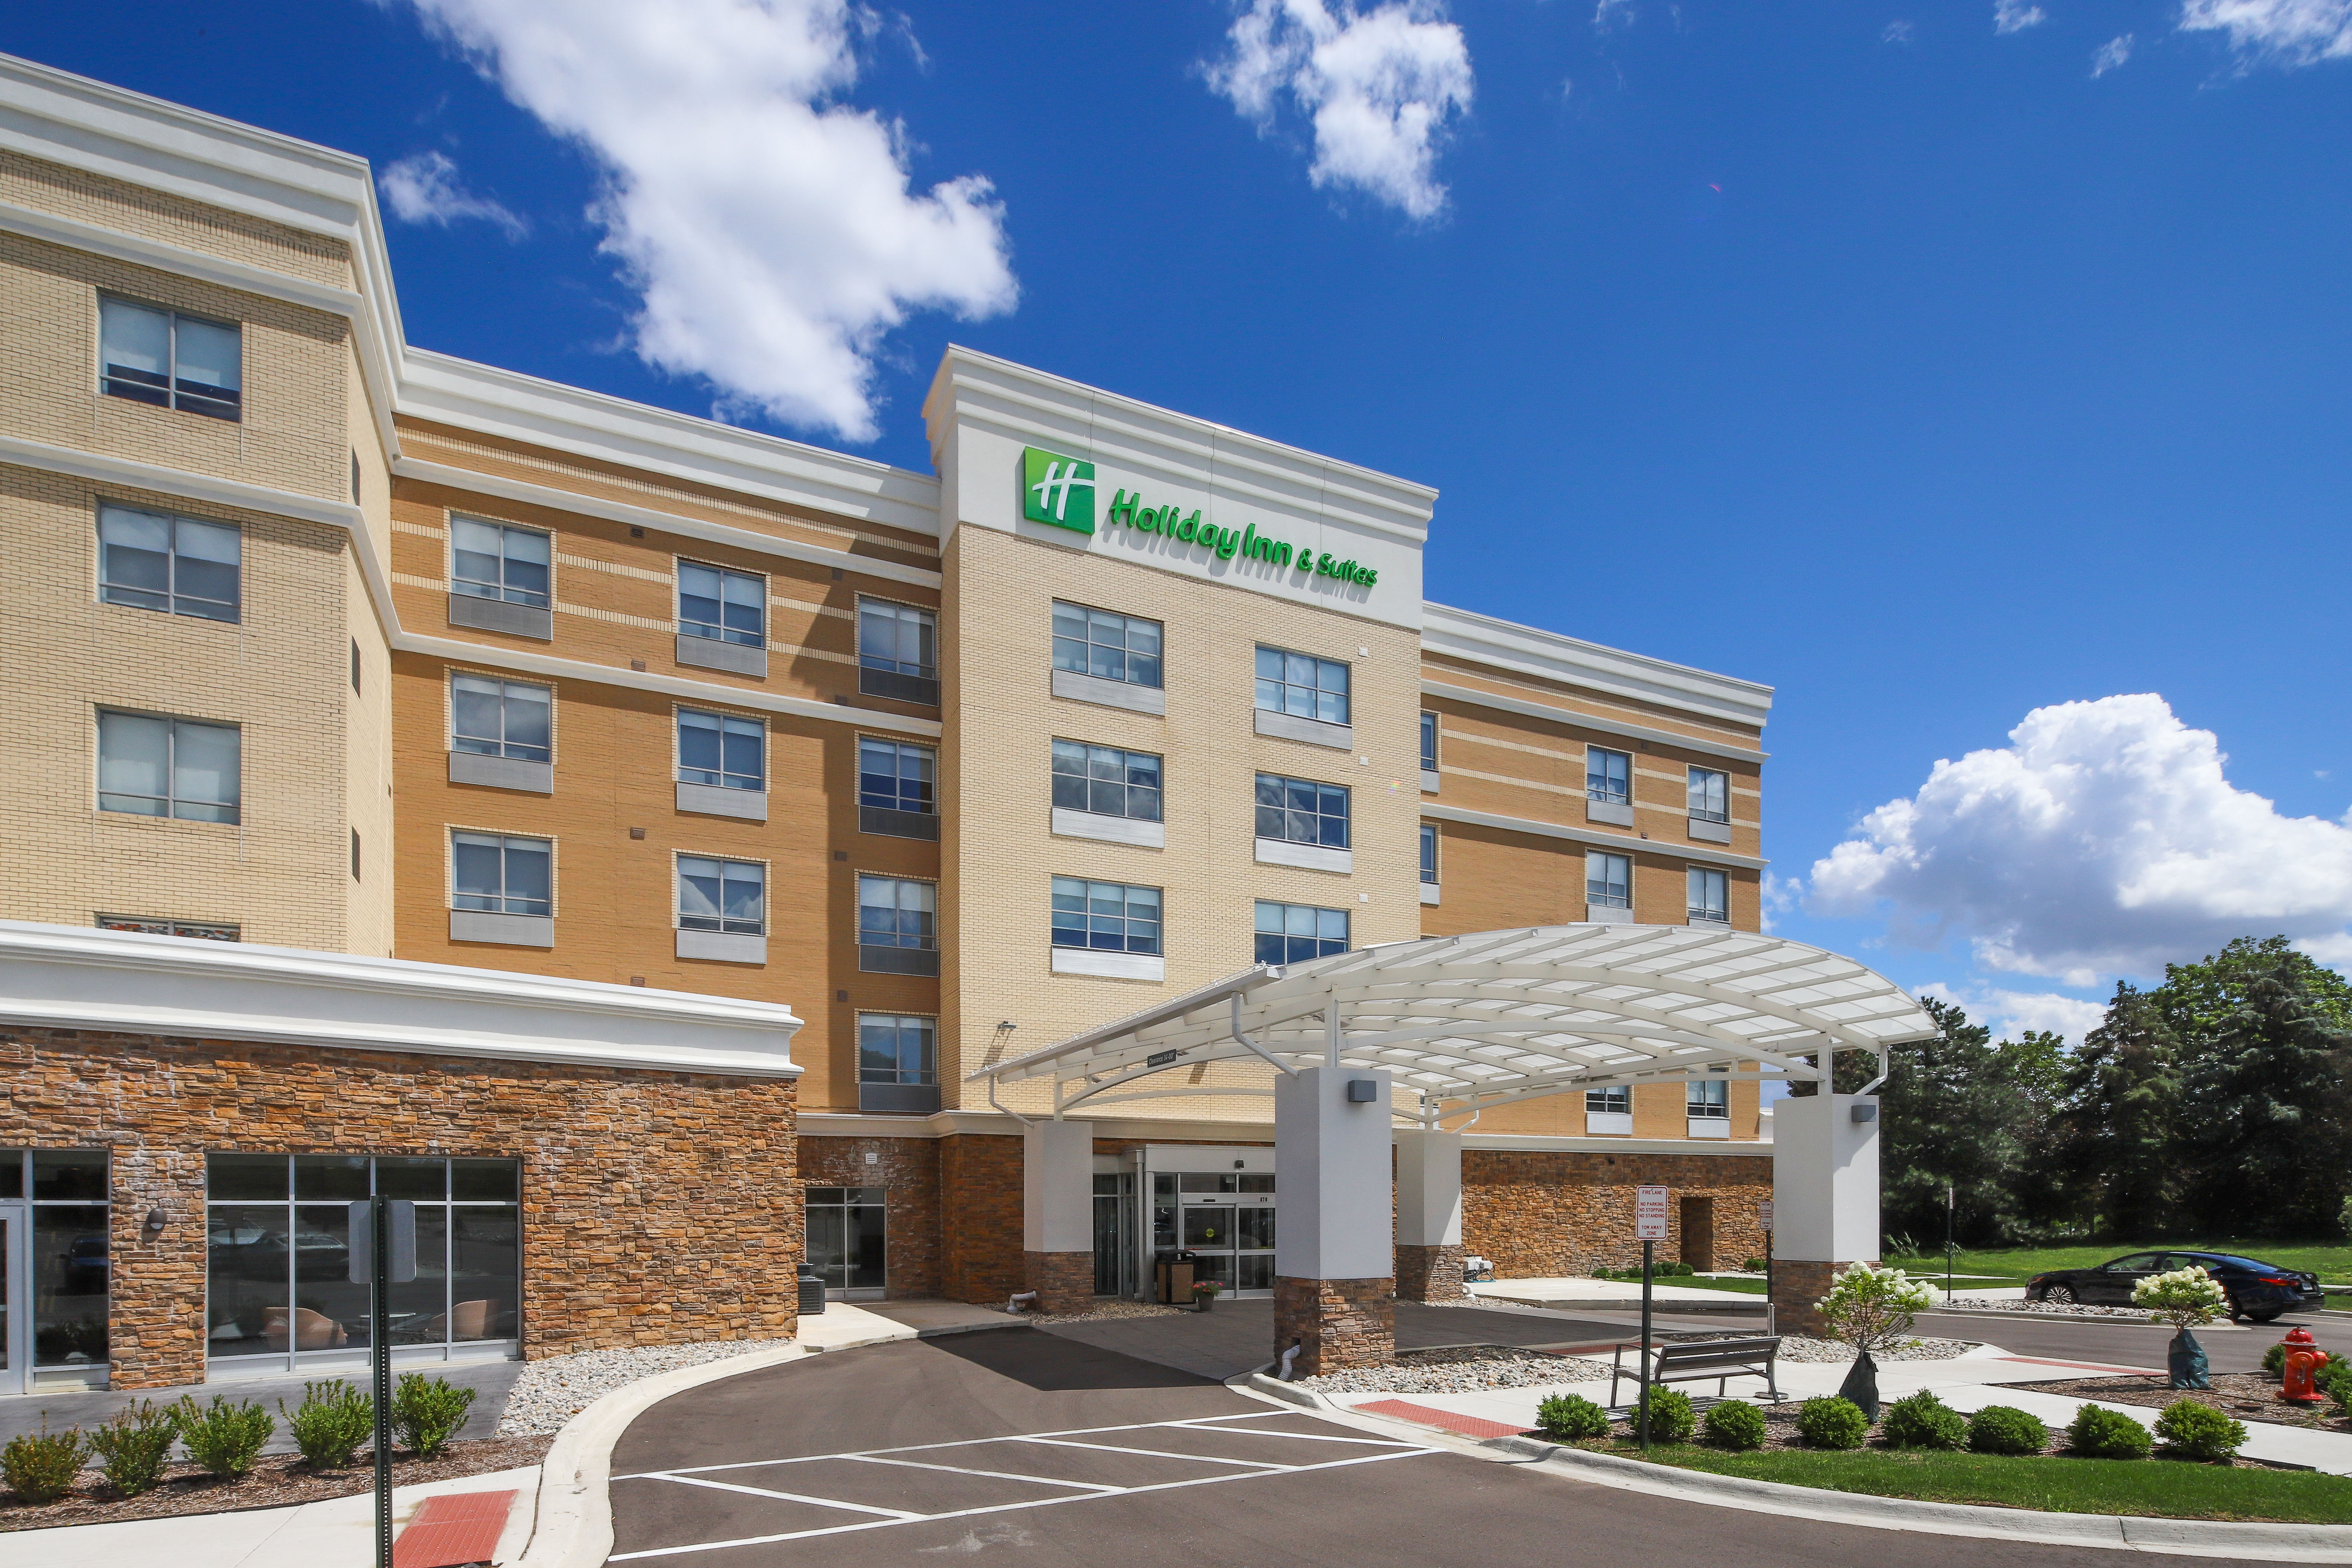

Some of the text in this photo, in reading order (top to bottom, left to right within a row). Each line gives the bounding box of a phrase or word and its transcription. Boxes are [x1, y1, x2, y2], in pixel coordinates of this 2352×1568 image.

[1109, 488, 1378, 587] Holiday Inn & Suites
[1149, 1056, 1163, 1064] Clearance
